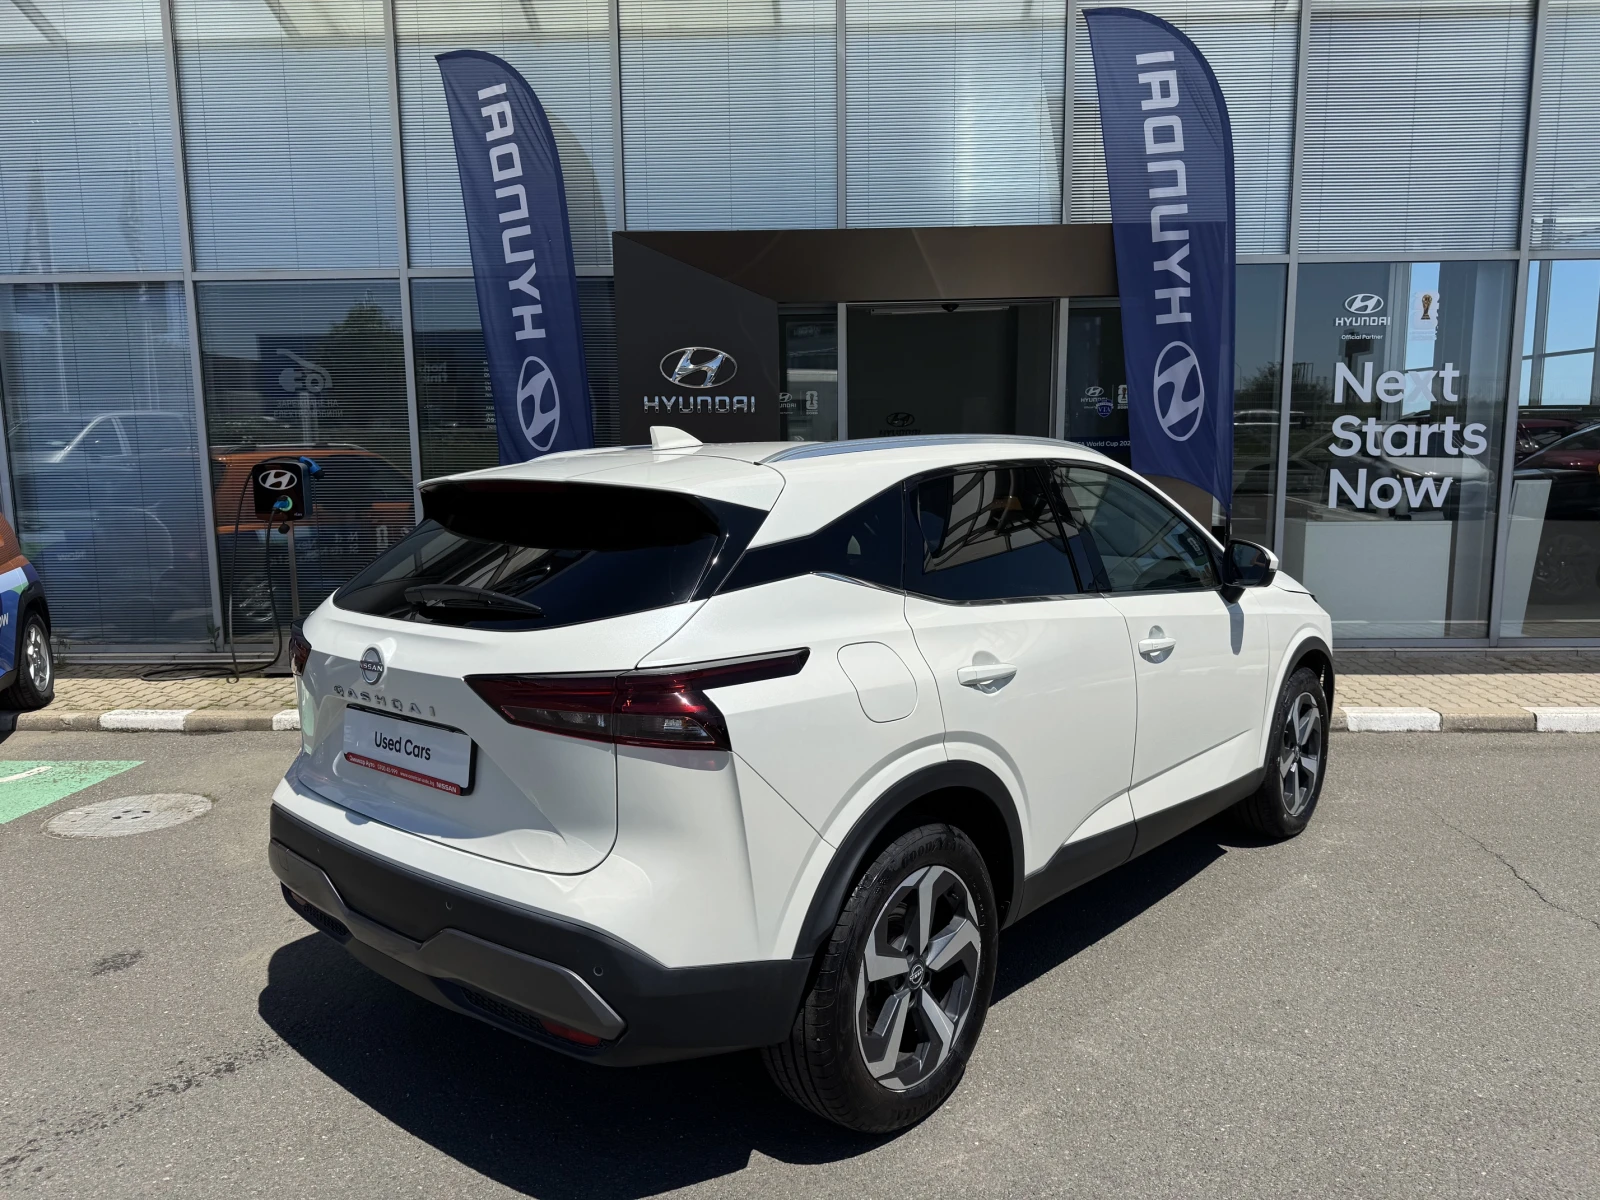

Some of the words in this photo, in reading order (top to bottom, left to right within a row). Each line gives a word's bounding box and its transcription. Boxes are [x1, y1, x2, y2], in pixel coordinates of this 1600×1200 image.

[1335, 316, 1391, 327] HYUNDAI
[1333, 361, 1460, 404] Next
[643, 395, 756, 414] HYUNDAI
[1327, 414, 1488, 457] Starts
[1328, 468, 1453, 509] Now
[333, 685, 436, 717] QASHQAI
[374, 731, 401, 753] Used
[404, 739, 431, 761] Cars
[436, 781, 457, 793] NISSAN
